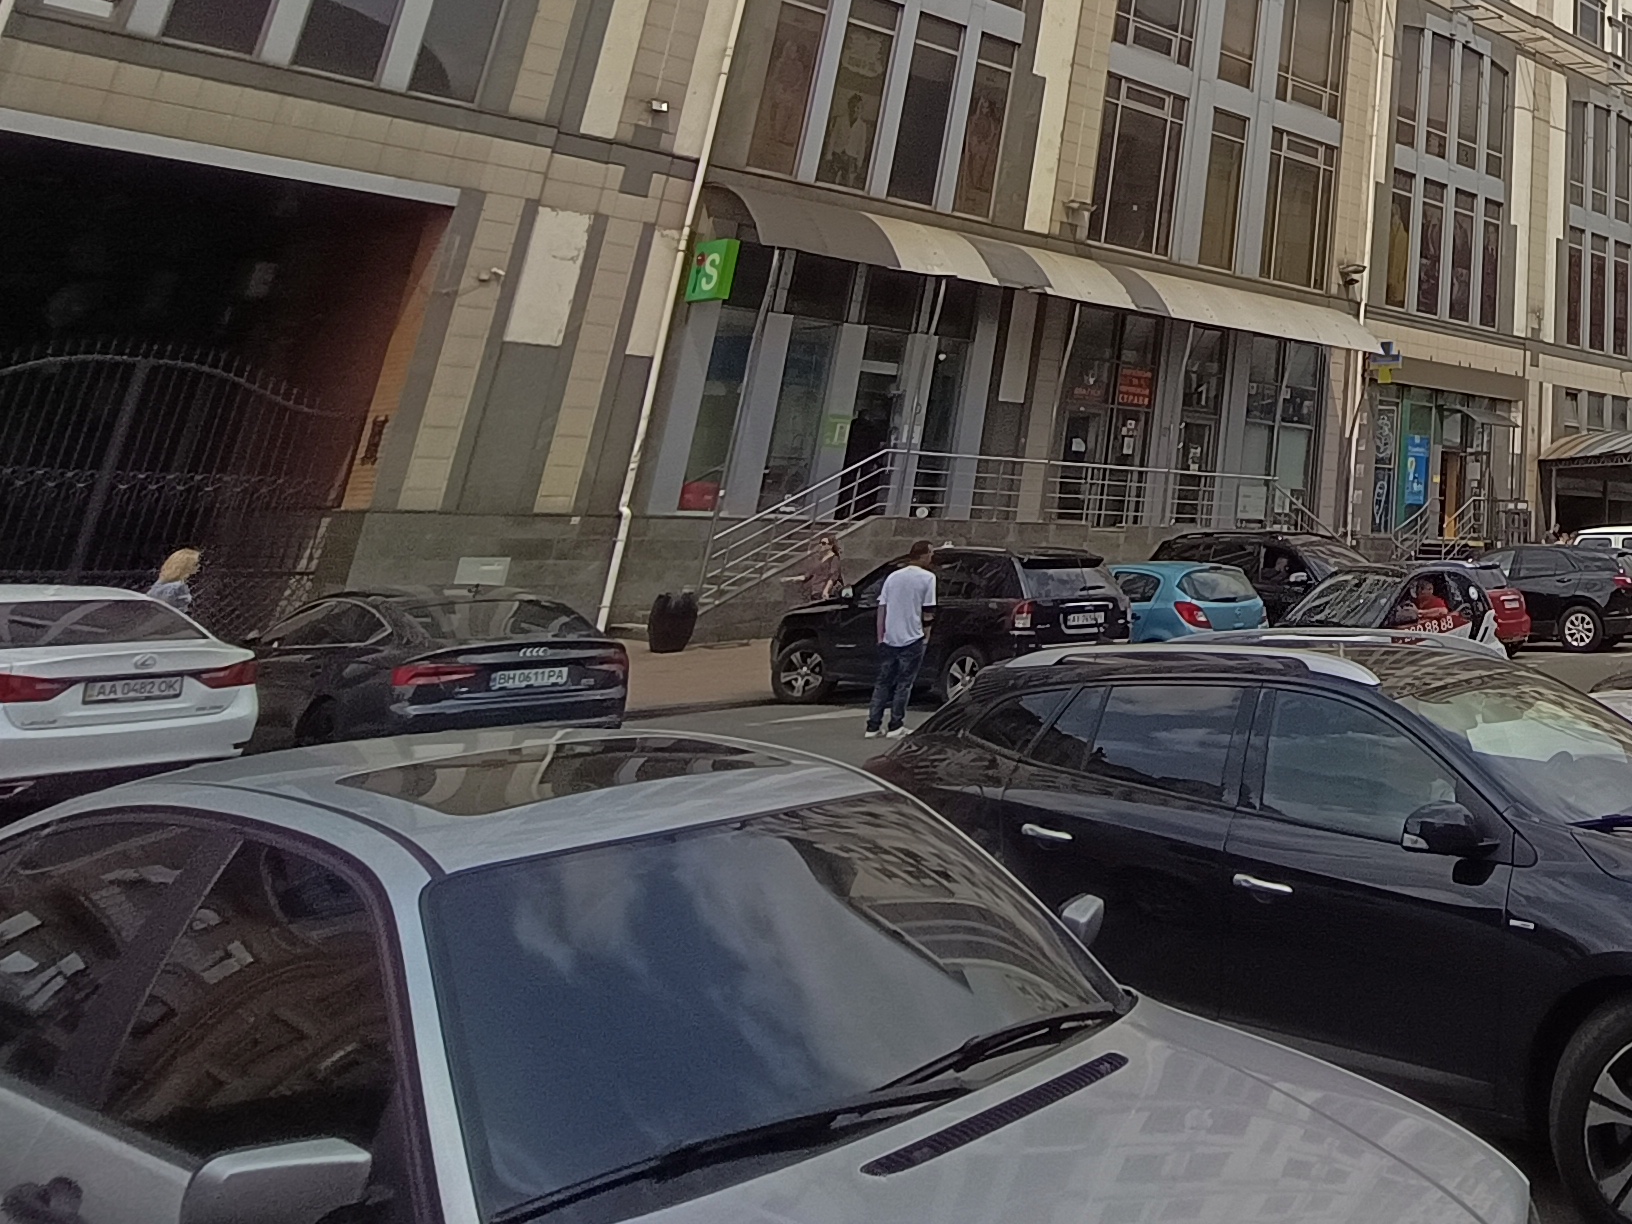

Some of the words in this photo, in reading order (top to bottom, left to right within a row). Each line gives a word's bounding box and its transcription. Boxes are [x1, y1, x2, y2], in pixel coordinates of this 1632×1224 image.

[499, 672, 516, 685] BH
[547, 669, 564, 681] PA
[96, 683, 118, 697] AA
[121, 681, 155, 695] 0482
[158, 678, 180, 693] OK
